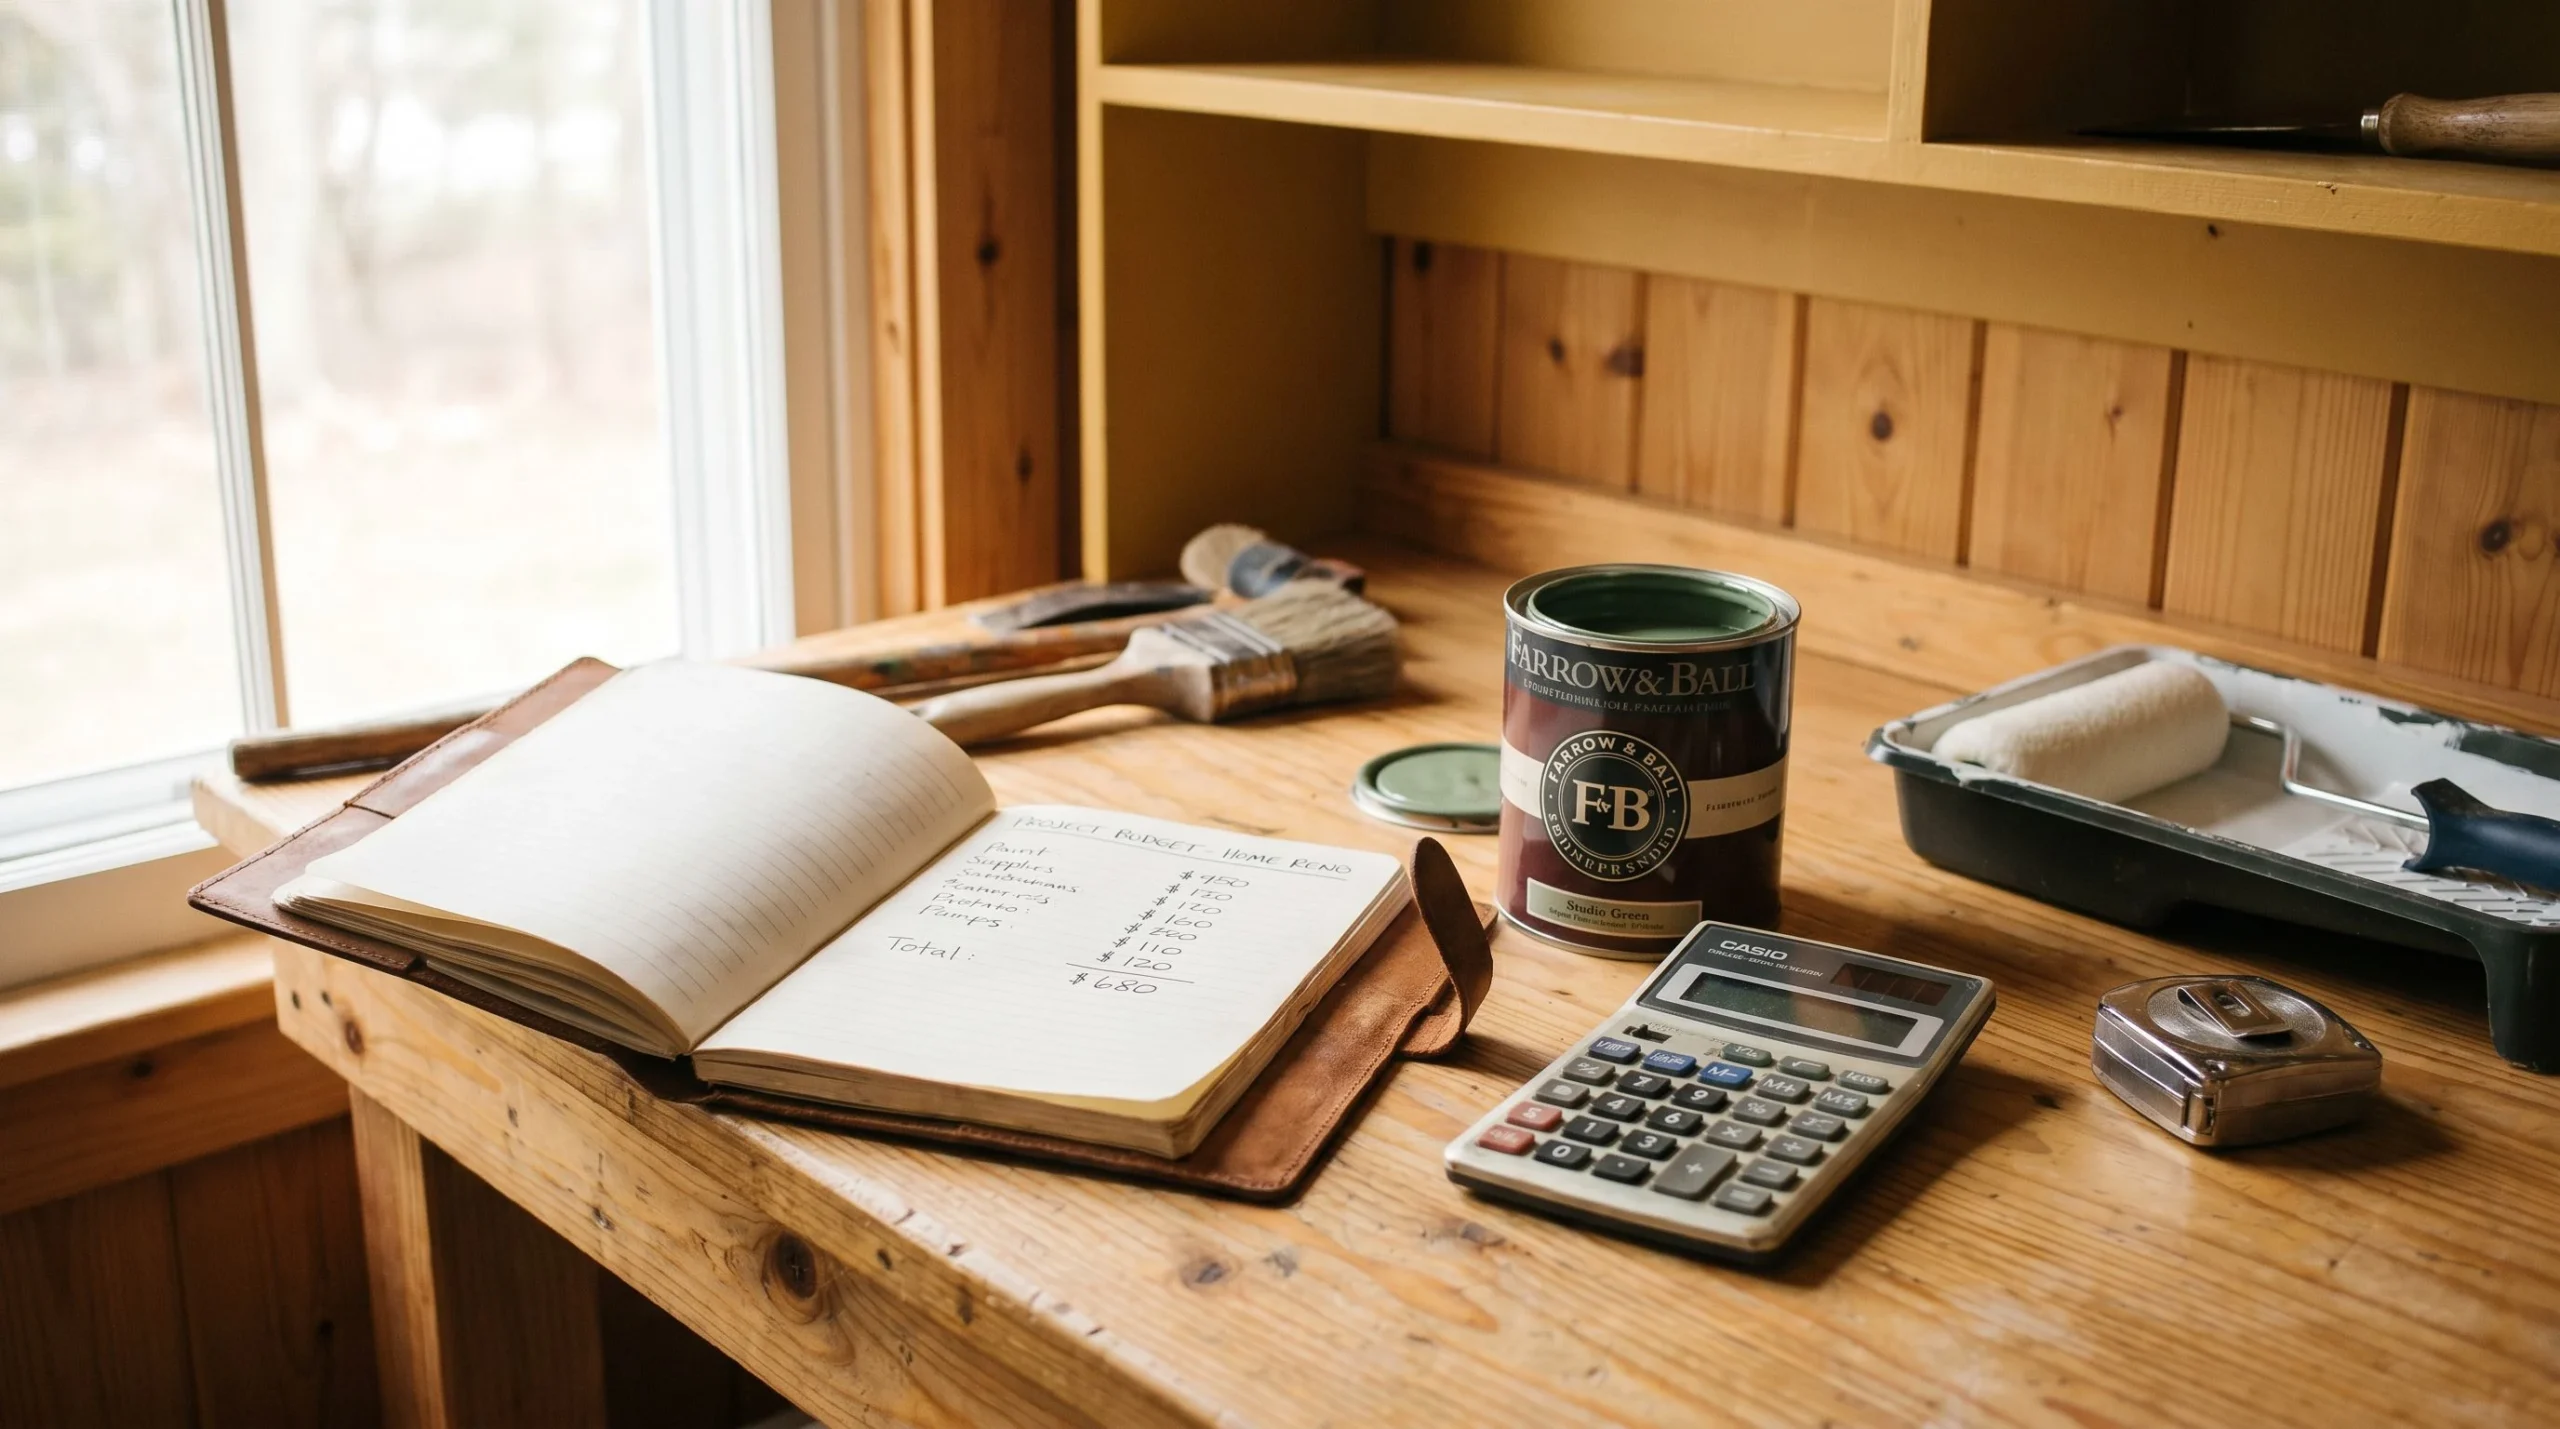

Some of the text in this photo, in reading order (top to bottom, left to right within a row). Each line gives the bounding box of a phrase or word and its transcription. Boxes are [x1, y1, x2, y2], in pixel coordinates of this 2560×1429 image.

[1548, 736, 1617, 784] FARROW
[1622, 741, 1637, 757] &
[1642, 752, 1680, 799] BALL
[983, 841, 1052, 857] Paint
[1012, 816, 1107, 835] PROJECT
[1222, 848, 1282, 866] HOME
[1289, 858, 1352, 875] RENO
[1566, 899, 1606, 917] Studio
[1610, 907, 1650, 922] Green
[1720, 939, 1788, 961] CASIO
[1606, 1098, 1626, 1111] 4
[1663, 1111, 1683, 1125] 6
[1636, 1135, 1659, 1149] 3
